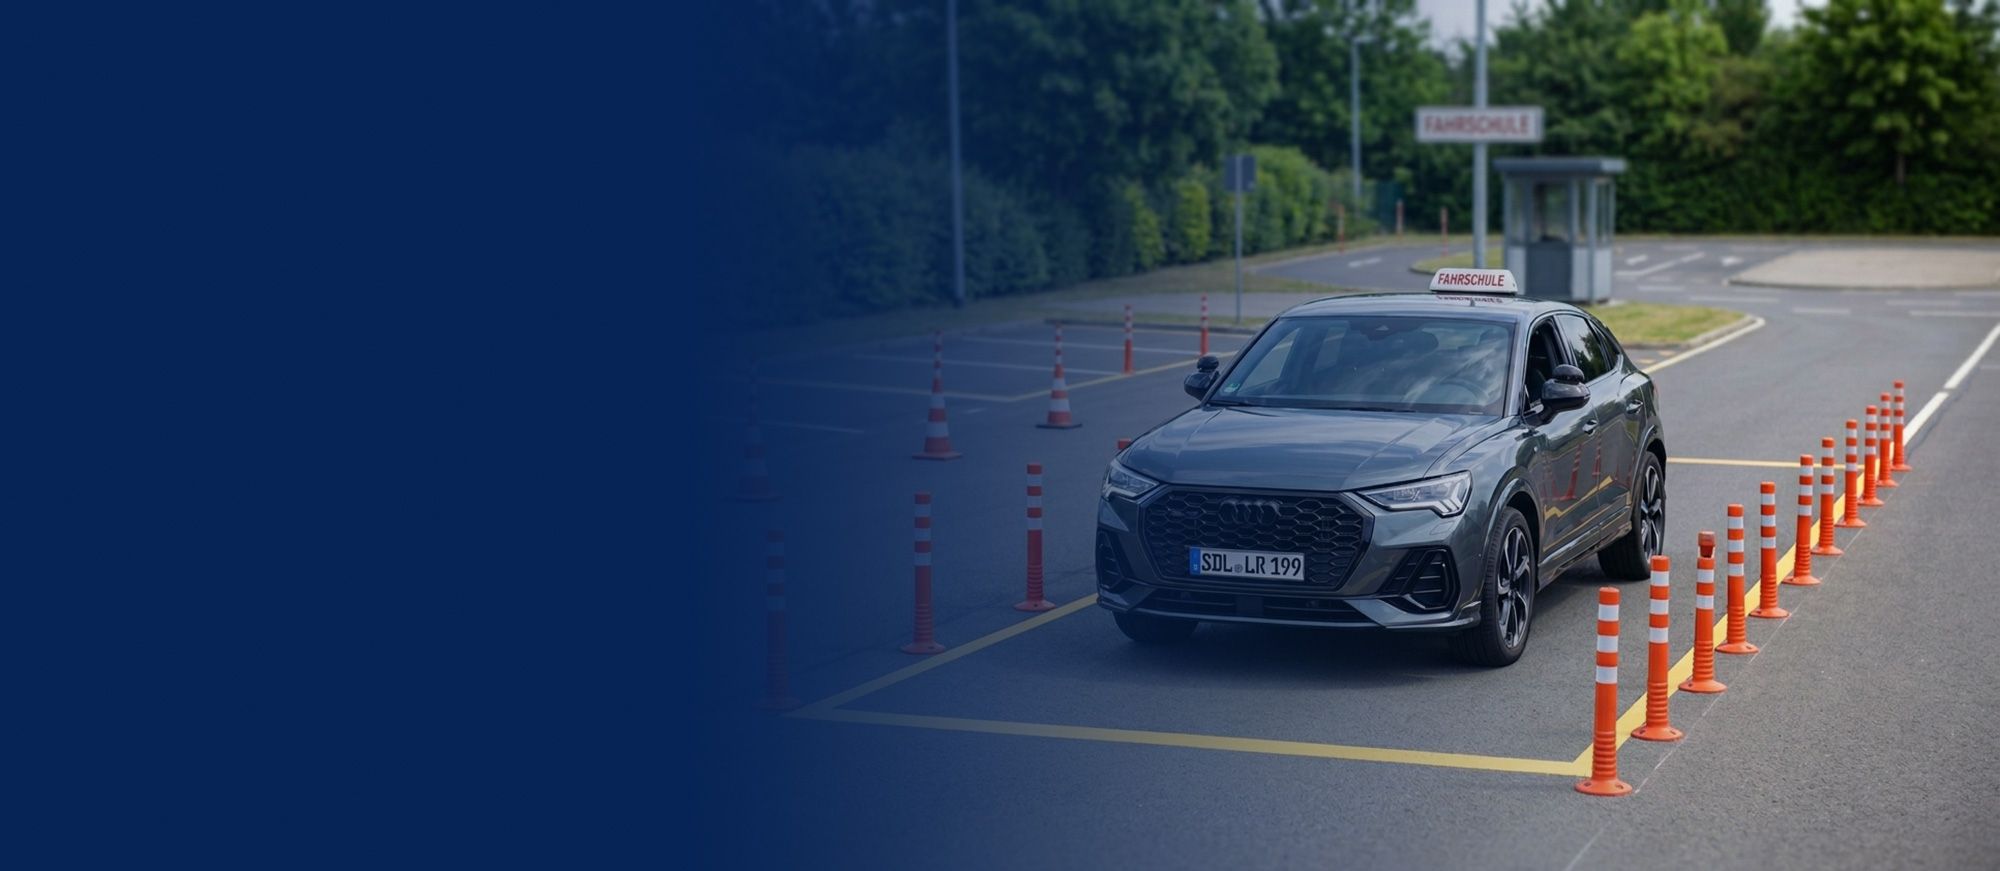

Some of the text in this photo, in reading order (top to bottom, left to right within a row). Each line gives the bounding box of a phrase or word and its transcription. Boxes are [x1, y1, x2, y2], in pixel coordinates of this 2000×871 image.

[1423, 114, 1530, 134] FAHRSCHULE
[1438, 273, 1504, 287] FAHRSCHULE
[1202, 553, 1301, 577] SDL LR 199
